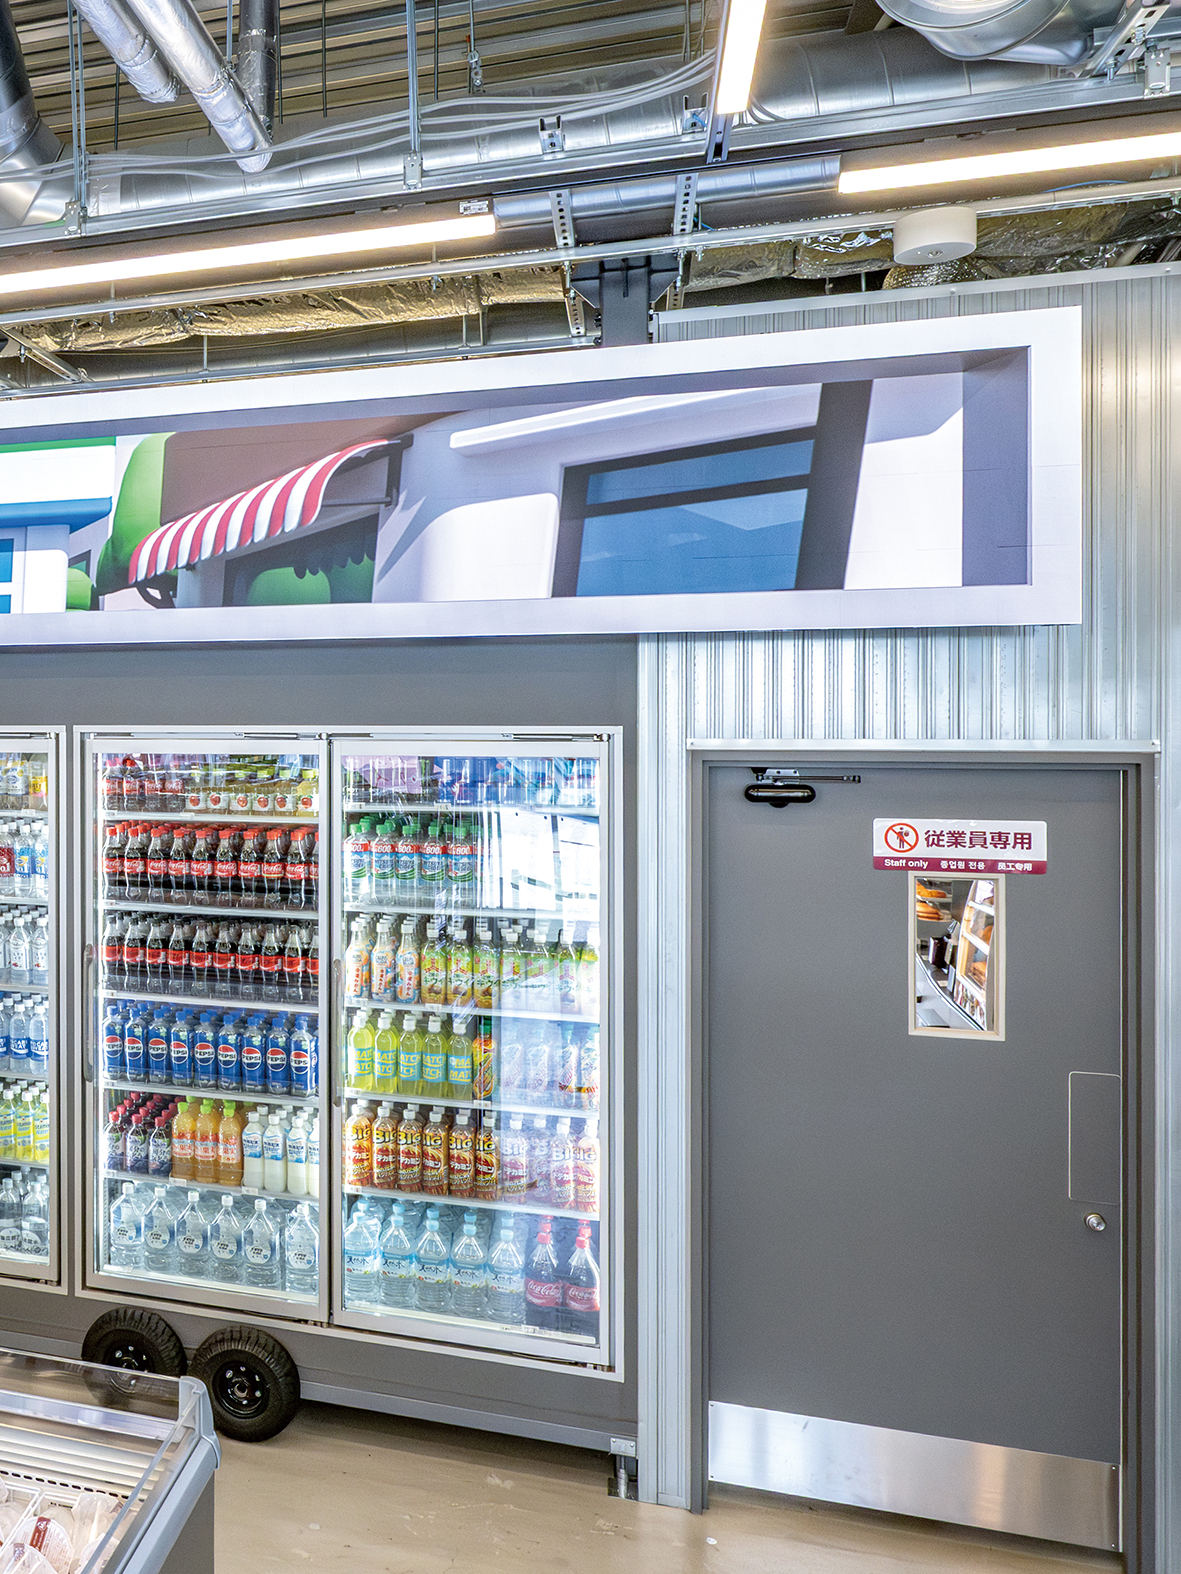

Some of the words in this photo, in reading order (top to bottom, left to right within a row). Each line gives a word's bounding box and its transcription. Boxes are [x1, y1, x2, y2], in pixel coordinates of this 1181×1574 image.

[924, 829, 1033, 851] 従業員専用
[884, 858, 906, 868] Staff
[908, 860, 929, 870] only
[968, 861, 986, 871] 전용
[997, 862, 1033, 872] 员工专用
